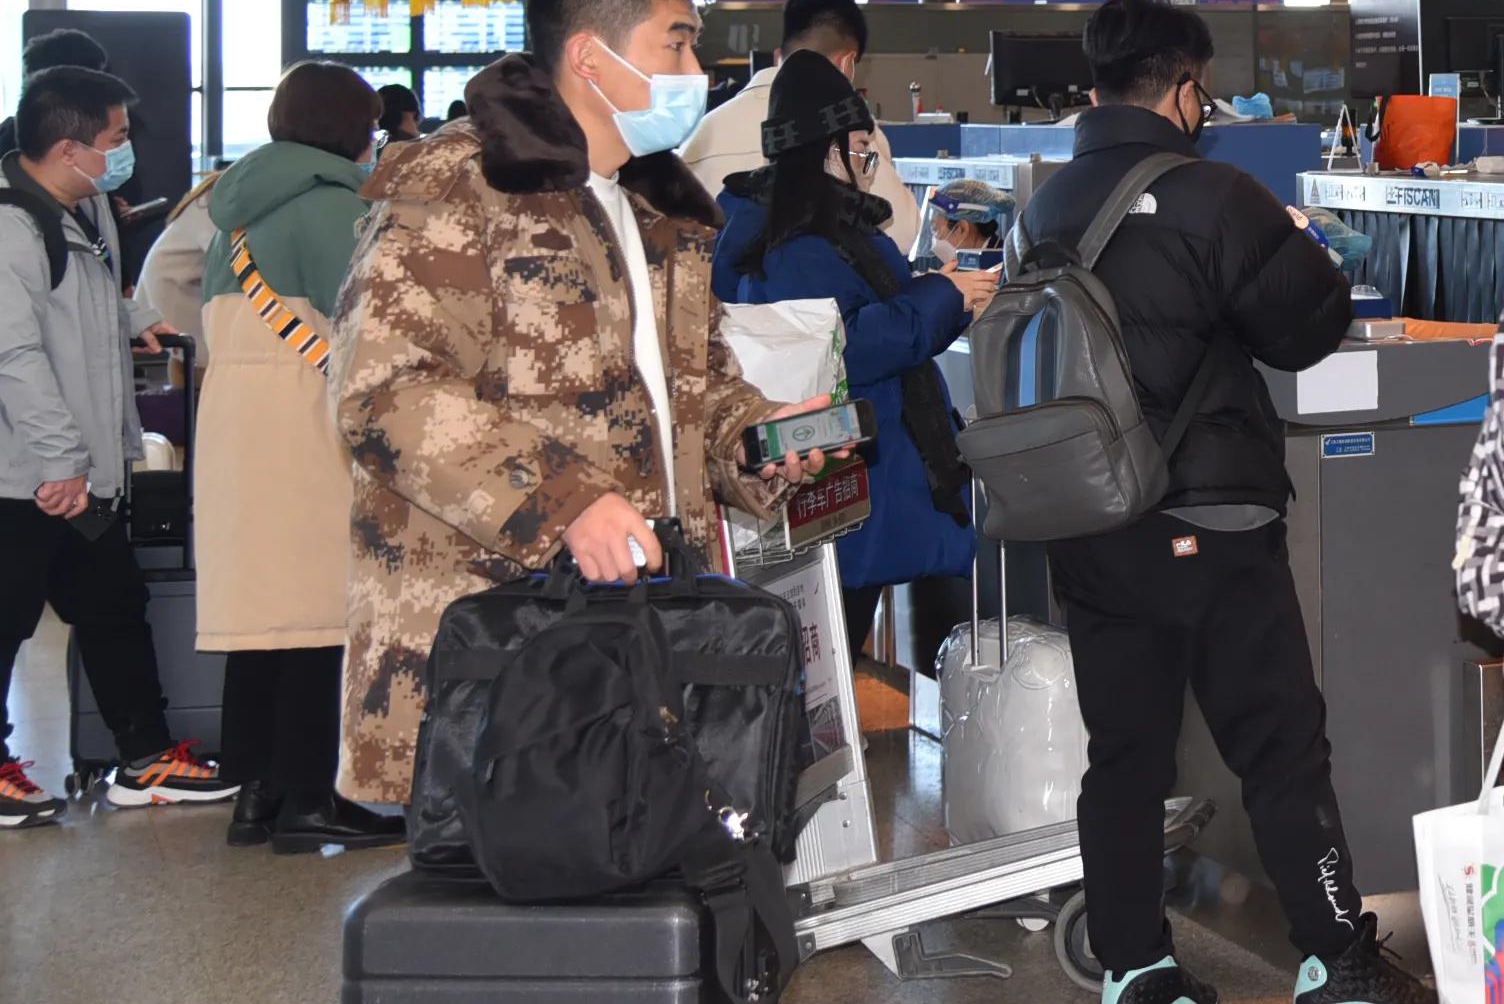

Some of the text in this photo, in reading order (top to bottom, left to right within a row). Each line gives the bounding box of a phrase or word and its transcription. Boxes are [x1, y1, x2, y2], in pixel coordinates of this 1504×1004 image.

[1397, 186, 1436, 206] FISCAN
[797, 473, 859, 519] 行李车广告招商
